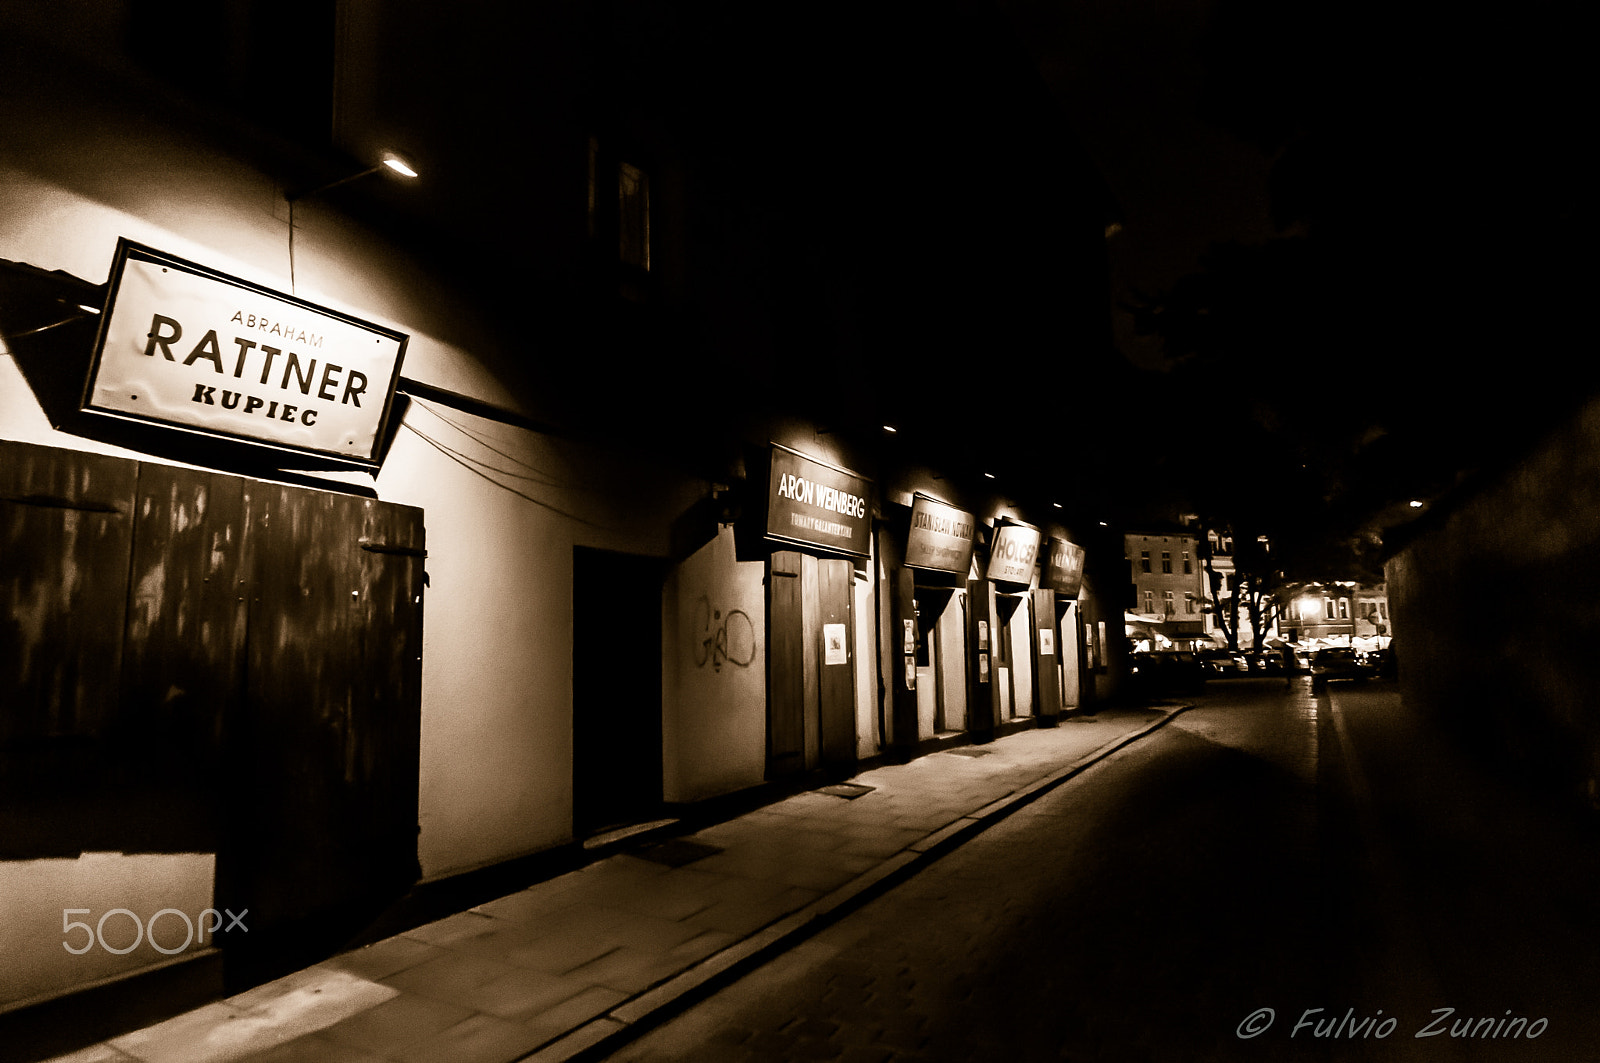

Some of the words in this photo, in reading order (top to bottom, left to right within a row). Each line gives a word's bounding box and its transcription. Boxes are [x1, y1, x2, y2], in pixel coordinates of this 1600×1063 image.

[231, 310, 323, 348] ABRAHAM
[144, 313, 368, 408] RATTNER
[191, 383, 318, 427] KUPIEC
[778, 473, 814, 505] ARON
[816, 484, 865, 519] WEINBERG
